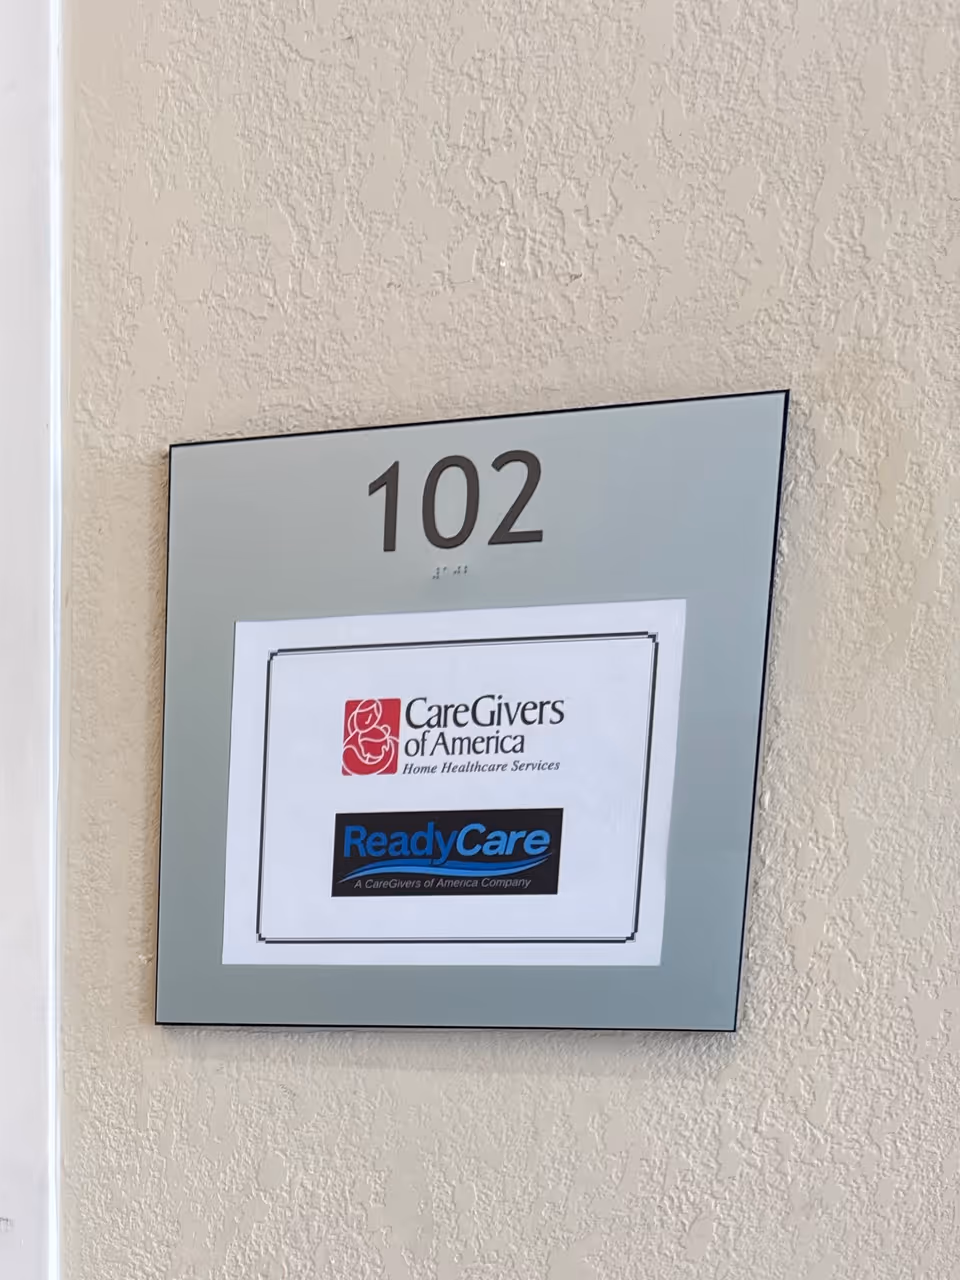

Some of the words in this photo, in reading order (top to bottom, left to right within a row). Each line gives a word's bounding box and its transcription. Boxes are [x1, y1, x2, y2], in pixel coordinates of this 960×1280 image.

[368, 450, 543, 552] 102
[406, 695, 564, 729] CareGivers
[404, 730, 430, 757] of
[430, 730, 524, 756] America
[403, 763, 437, 775] Home
[441, 761, 507, 773] Healthcare
[511, 760, 560, 772] Services
[344, 822, 550, 865] ReadyCare
[354, 880, 362, 889] A
[365, 879, 420, 889] CareGivers
[424, 878, 434, 888] of
[436, 878, 477, 888] America
[481, 878, 531, 889] Company
